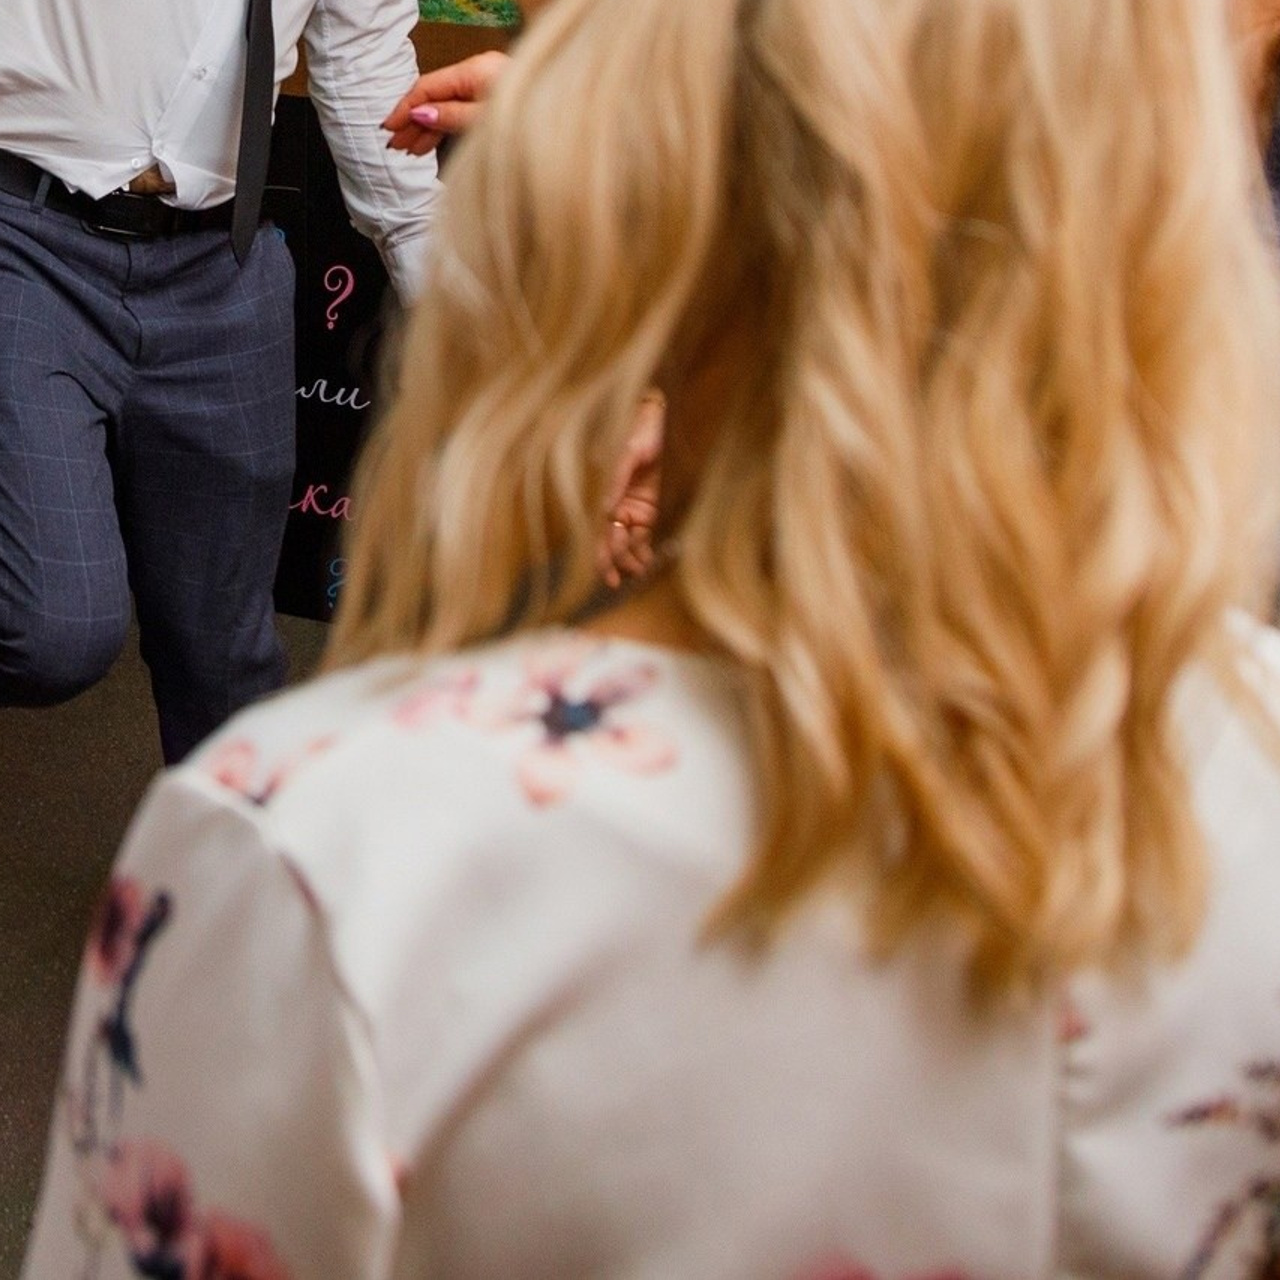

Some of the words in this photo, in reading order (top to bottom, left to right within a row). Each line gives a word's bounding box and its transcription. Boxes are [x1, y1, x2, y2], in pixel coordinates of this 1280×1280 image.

[324, 265, 354, 330] ?
[295, 378, 371, 410] ли
[289, 484, 352, 520] ка
